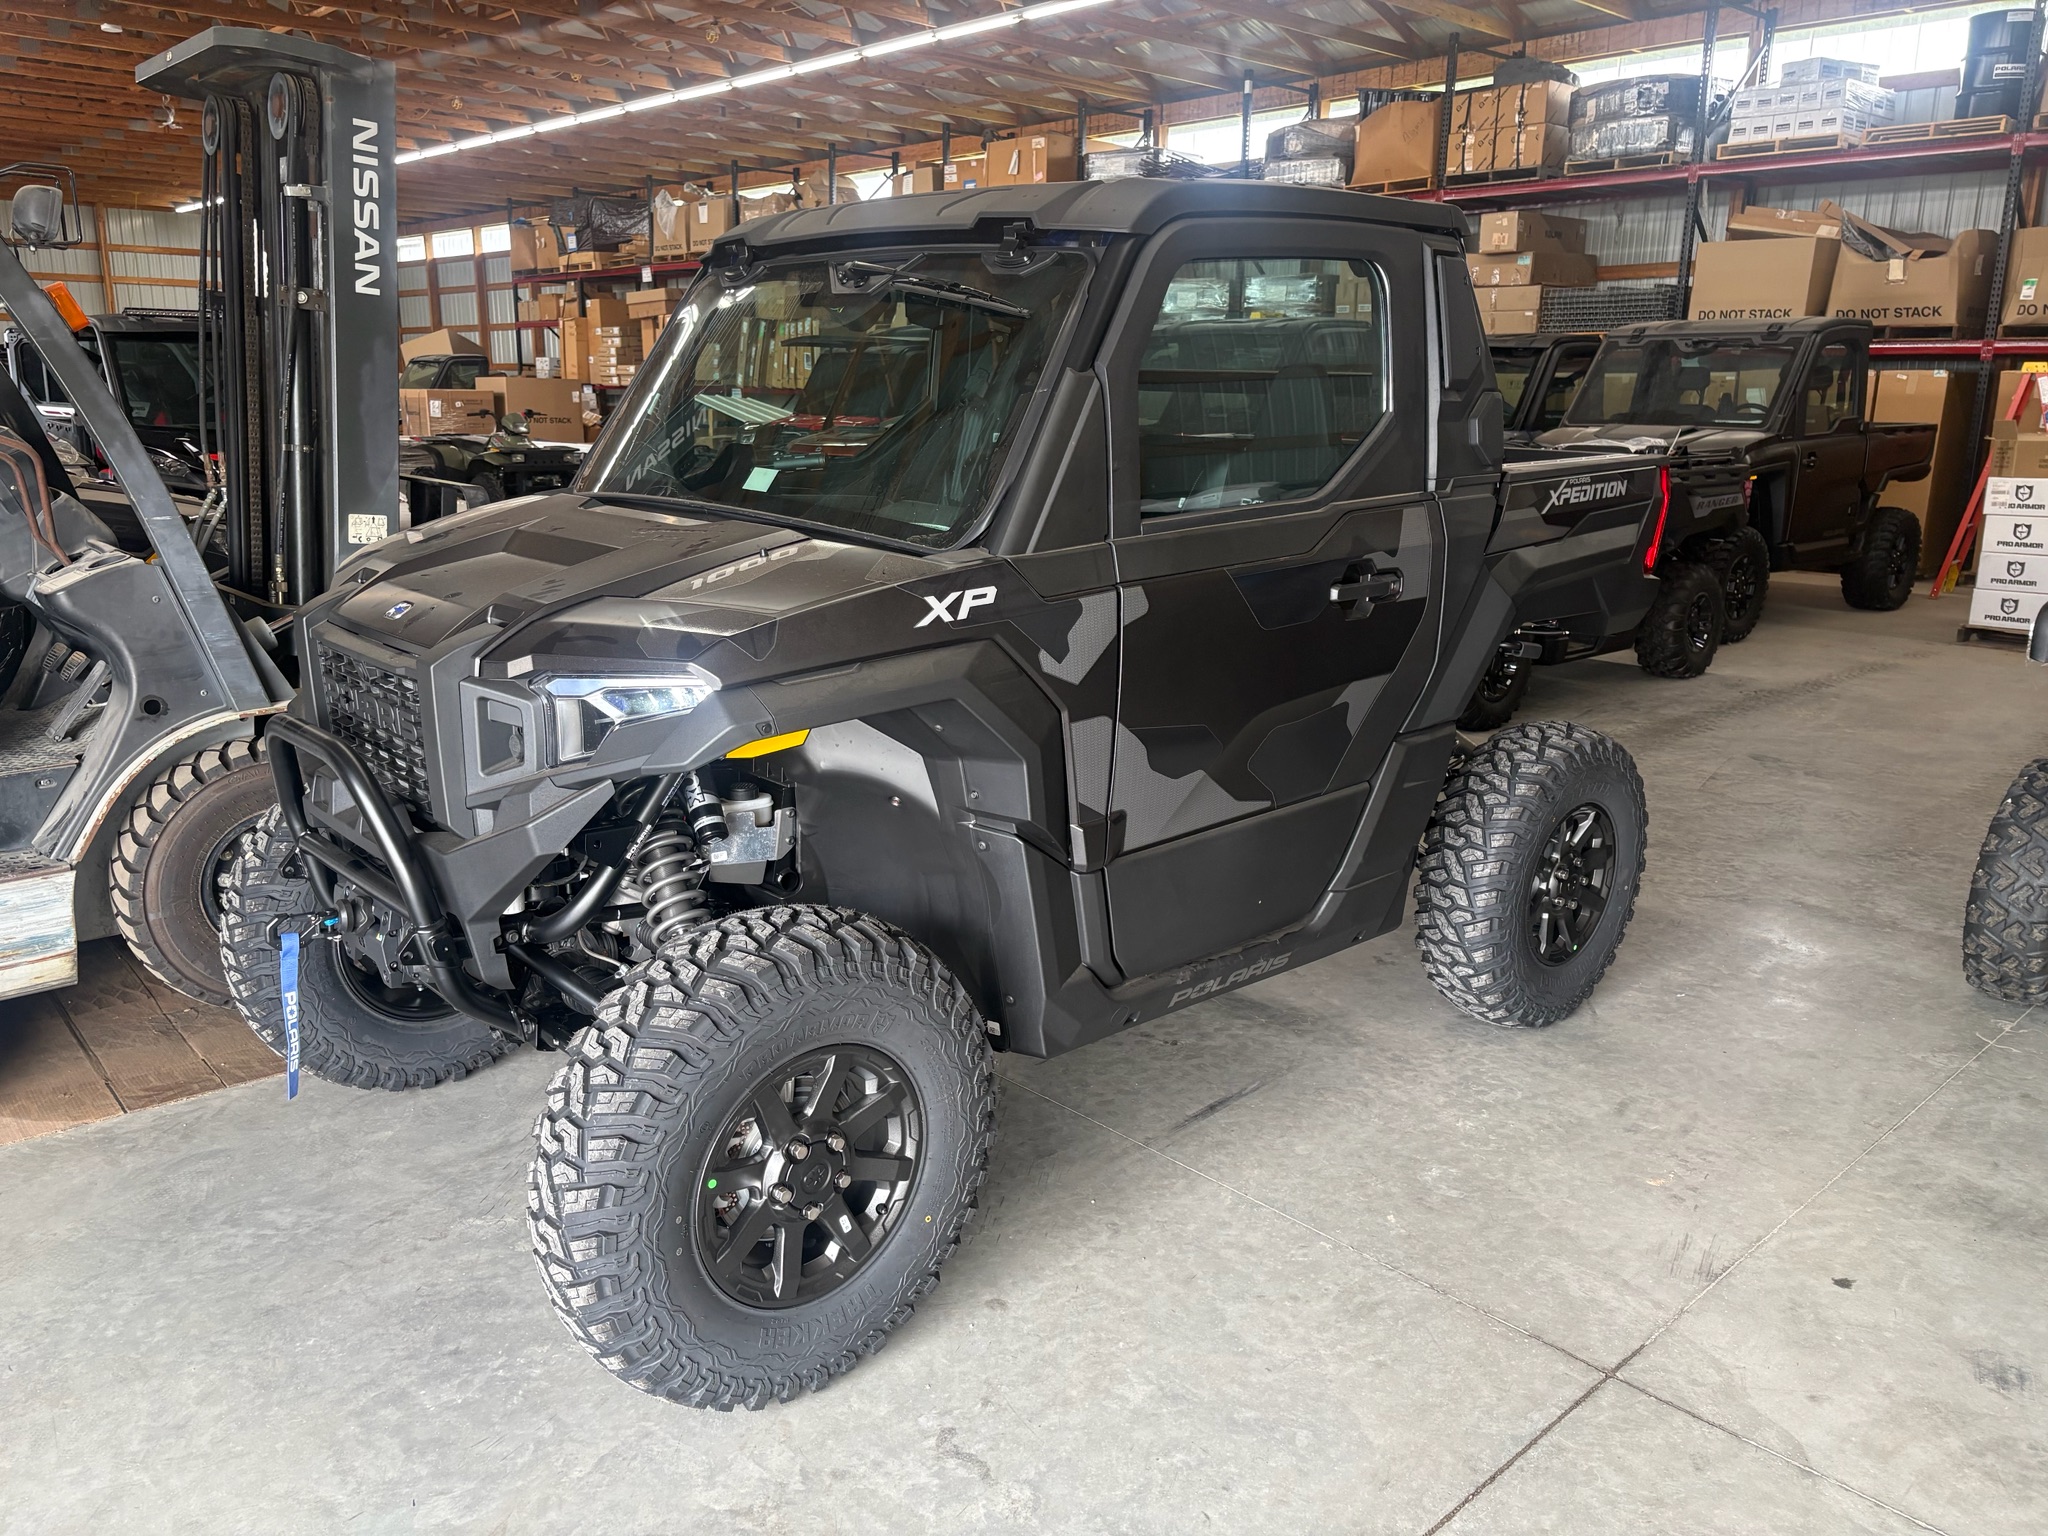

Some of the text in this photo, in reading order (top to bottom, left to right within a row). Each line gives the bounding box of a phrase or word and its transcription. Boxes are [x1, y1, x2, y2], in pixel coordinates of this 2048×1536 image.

[352, 117, 381, 296] NISSAN
[1698, 308, 1793, 320] DO NOT STACK
[1836, 305, 1943, 319] DO NOT STACK
[2016, 303, 2038, 316] DO
[549, 416, 572, 425] STACK
[1569, 476, 1592, 485] POLARIS
[1541, 479, 1628, 515] XPEDITION
[1696, 495, 1739, 510] RANGER
[2014, 541, 2044, 549] ARMOR
[691, 547, 799, 590] 1000
[1990, 577, 2037, 587] PRO ARMOR
[914, 585, 998, 628] XP
[2001, 616, 2030, 624] ARMOR
[1168, 951, 1293, 1009] POLARIS
[284, 991, 299, 1073] POLARIS
